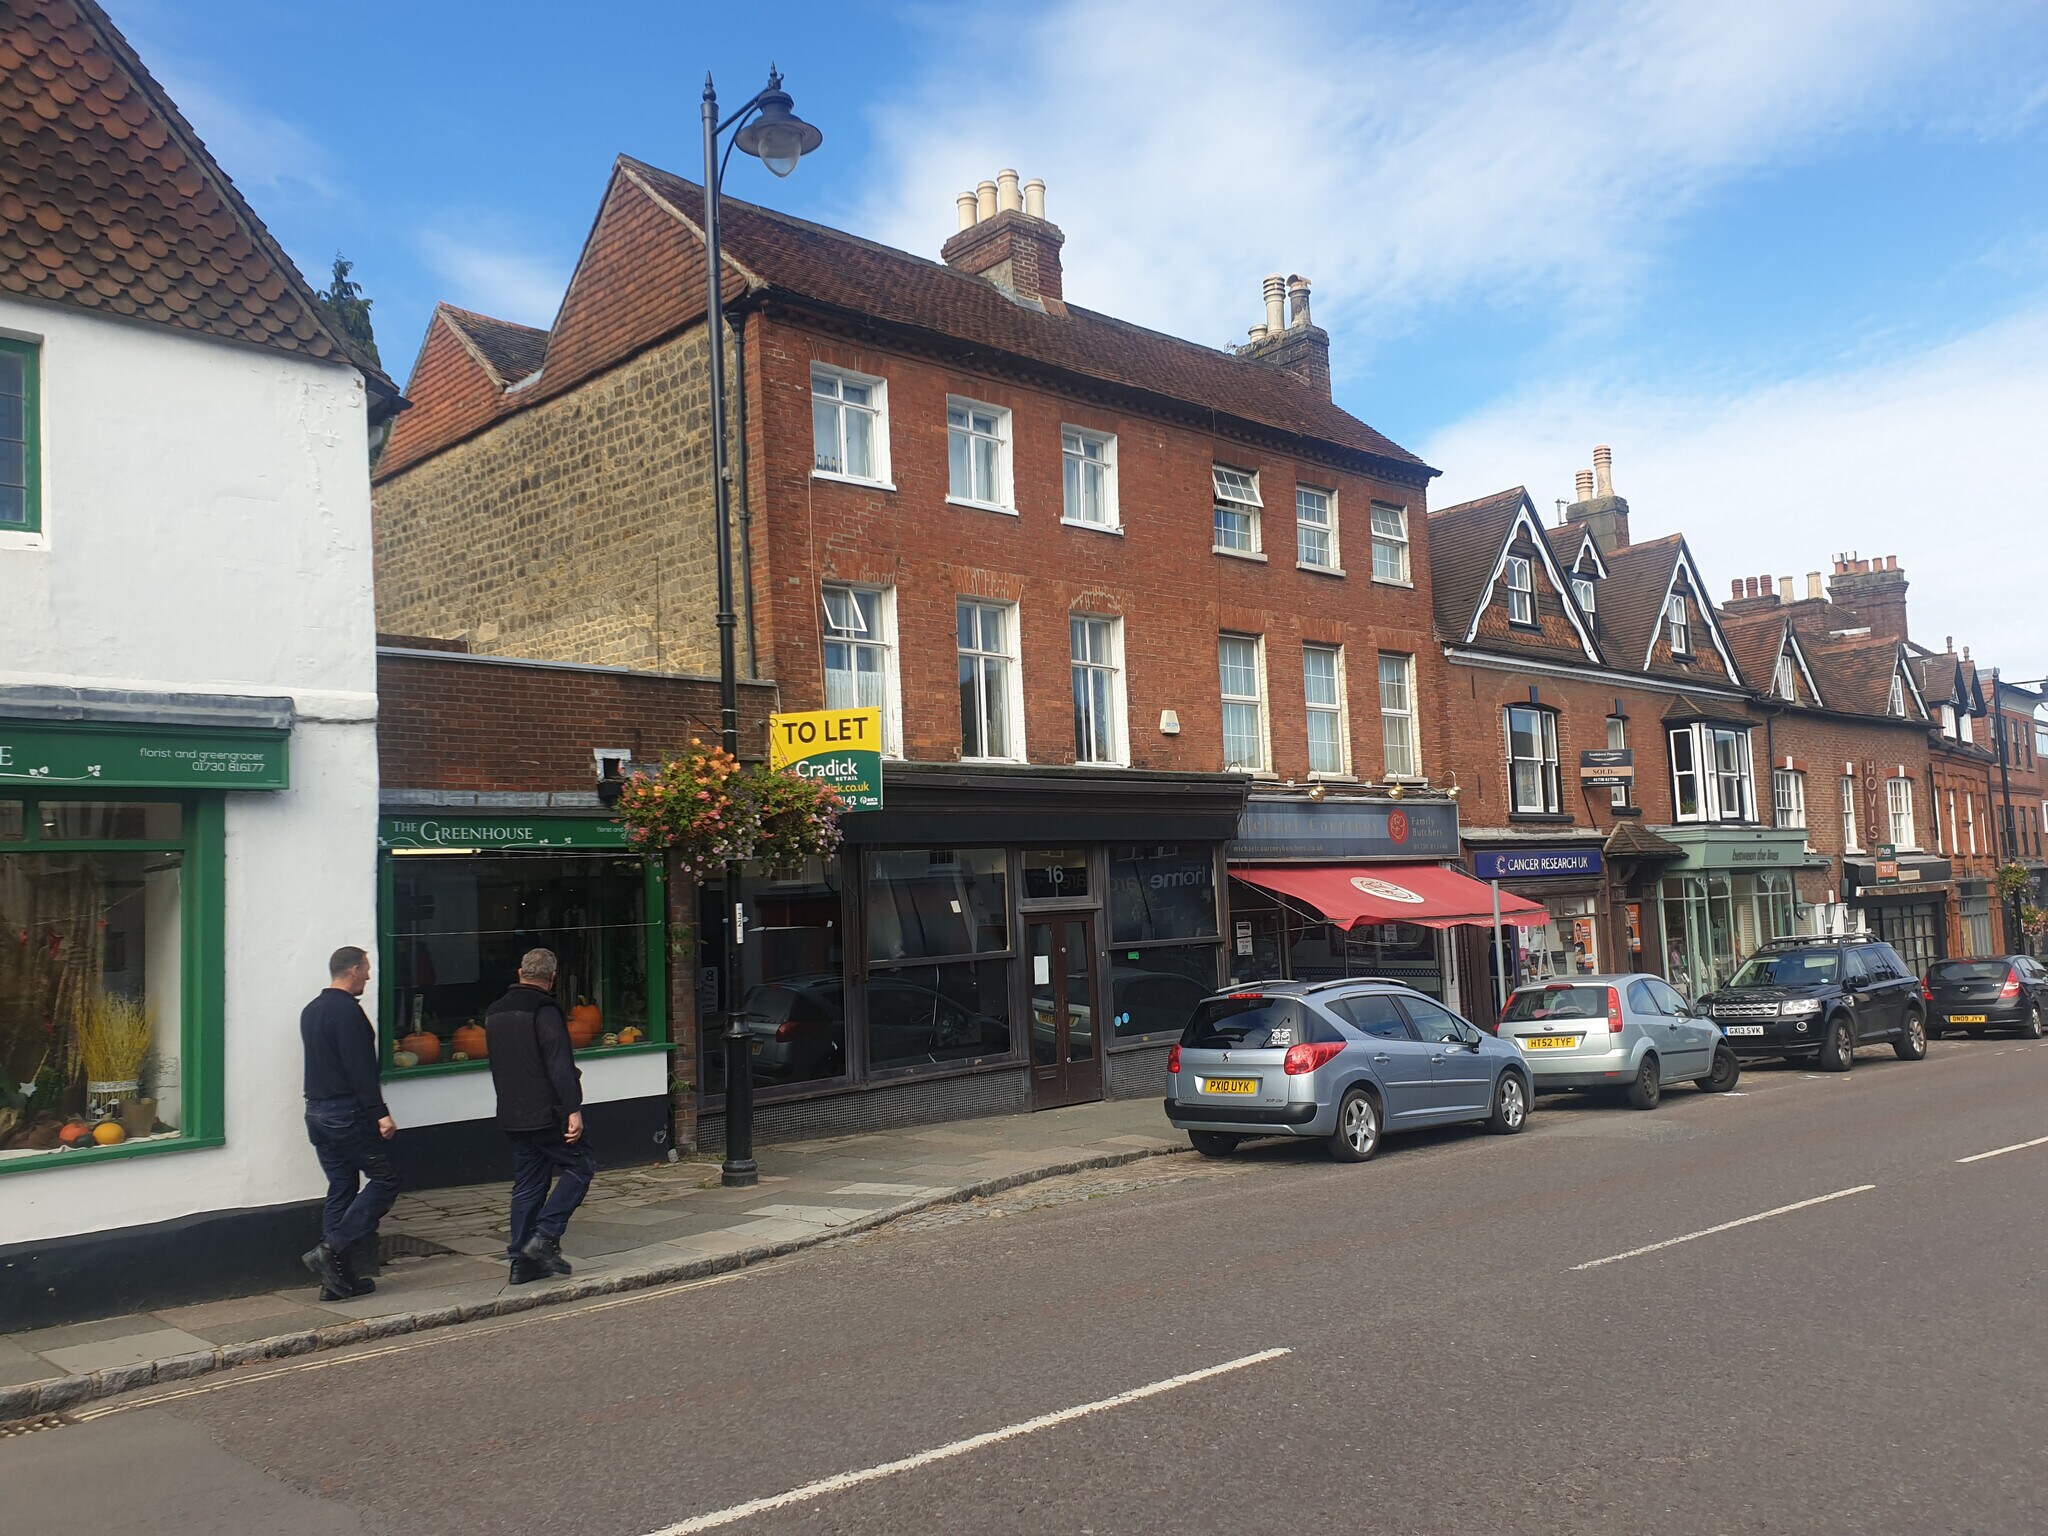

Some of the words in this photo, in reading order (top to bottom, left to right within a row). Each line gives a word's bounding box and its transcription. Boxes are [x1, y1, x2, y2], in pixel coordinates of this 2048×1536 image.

[782, 721, 816, 744] TO
[825, 717, 868, 741] LET
[140, 748, 171, 757] florist
[175, 750, 196, 759] and
[199, 752, 264, 763] greengrocer
[192, 762, 225, 771] 01730
[228, 763, 265, 772] 816177
[796, 758, 858, 777] Cradick
[1866, 760, 1878, 839] HOVIS
[392, 821, 418, 832] THE
[1412, 816, 1434, 826] Family
[1412, 827, 1443, 837] Butchers
[1507, 858, 1539, 871] CANCER
[1541, 857, 1577, 870] RESEARCH
[1578, 856, 1589, 869] UK
[1045, 864, 1064, 883] 16
[1729, 1027, 1745, 1035] GX13
[1531, 1038, 1552, 1047] HT52
[1554, 1037, 1572, 1046] TYF
[1209, 1080, 1229, 1091] PX10
[1231, 1081, 1250, 1092] UYK
